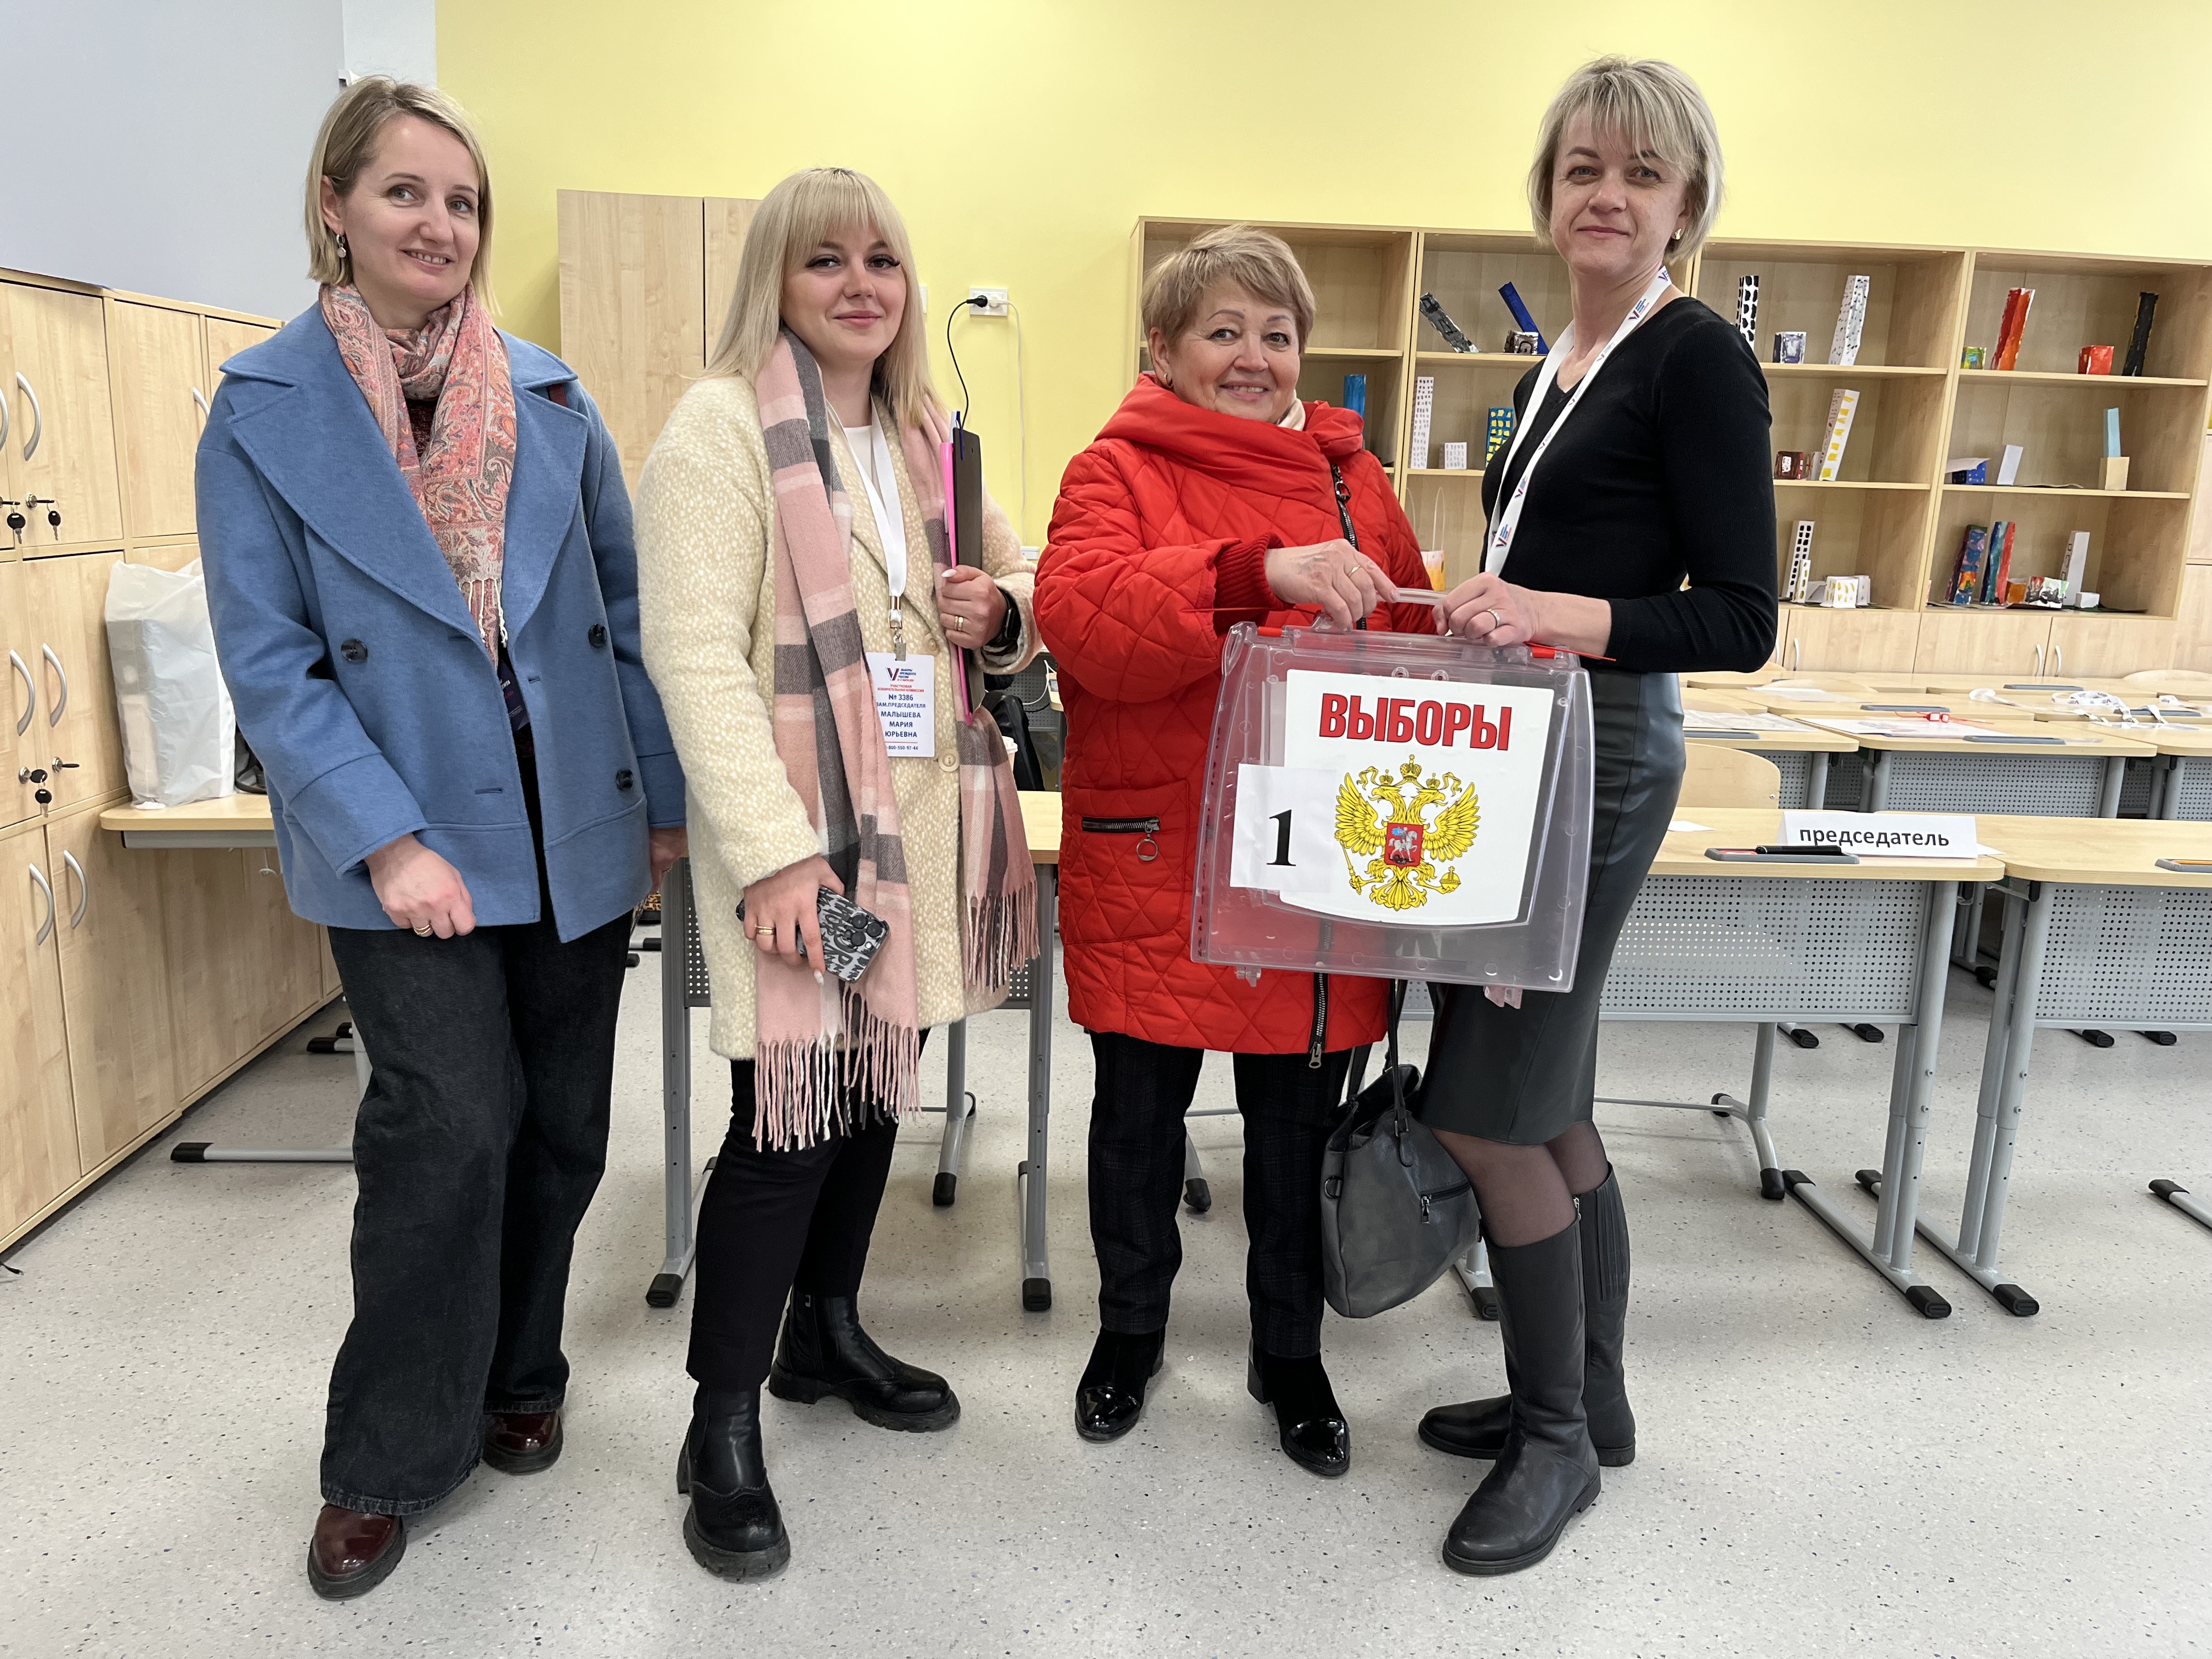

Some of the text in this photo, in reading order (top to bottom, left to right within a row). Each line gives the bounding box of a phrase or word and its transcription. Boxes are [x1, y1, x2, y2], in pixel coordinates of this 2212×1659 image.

[1319, 692, 1513, 751] ВЫБОРЫ
[1266, 809, 1296, 867] 1
[1799, 829, 1949, 848] председатель
